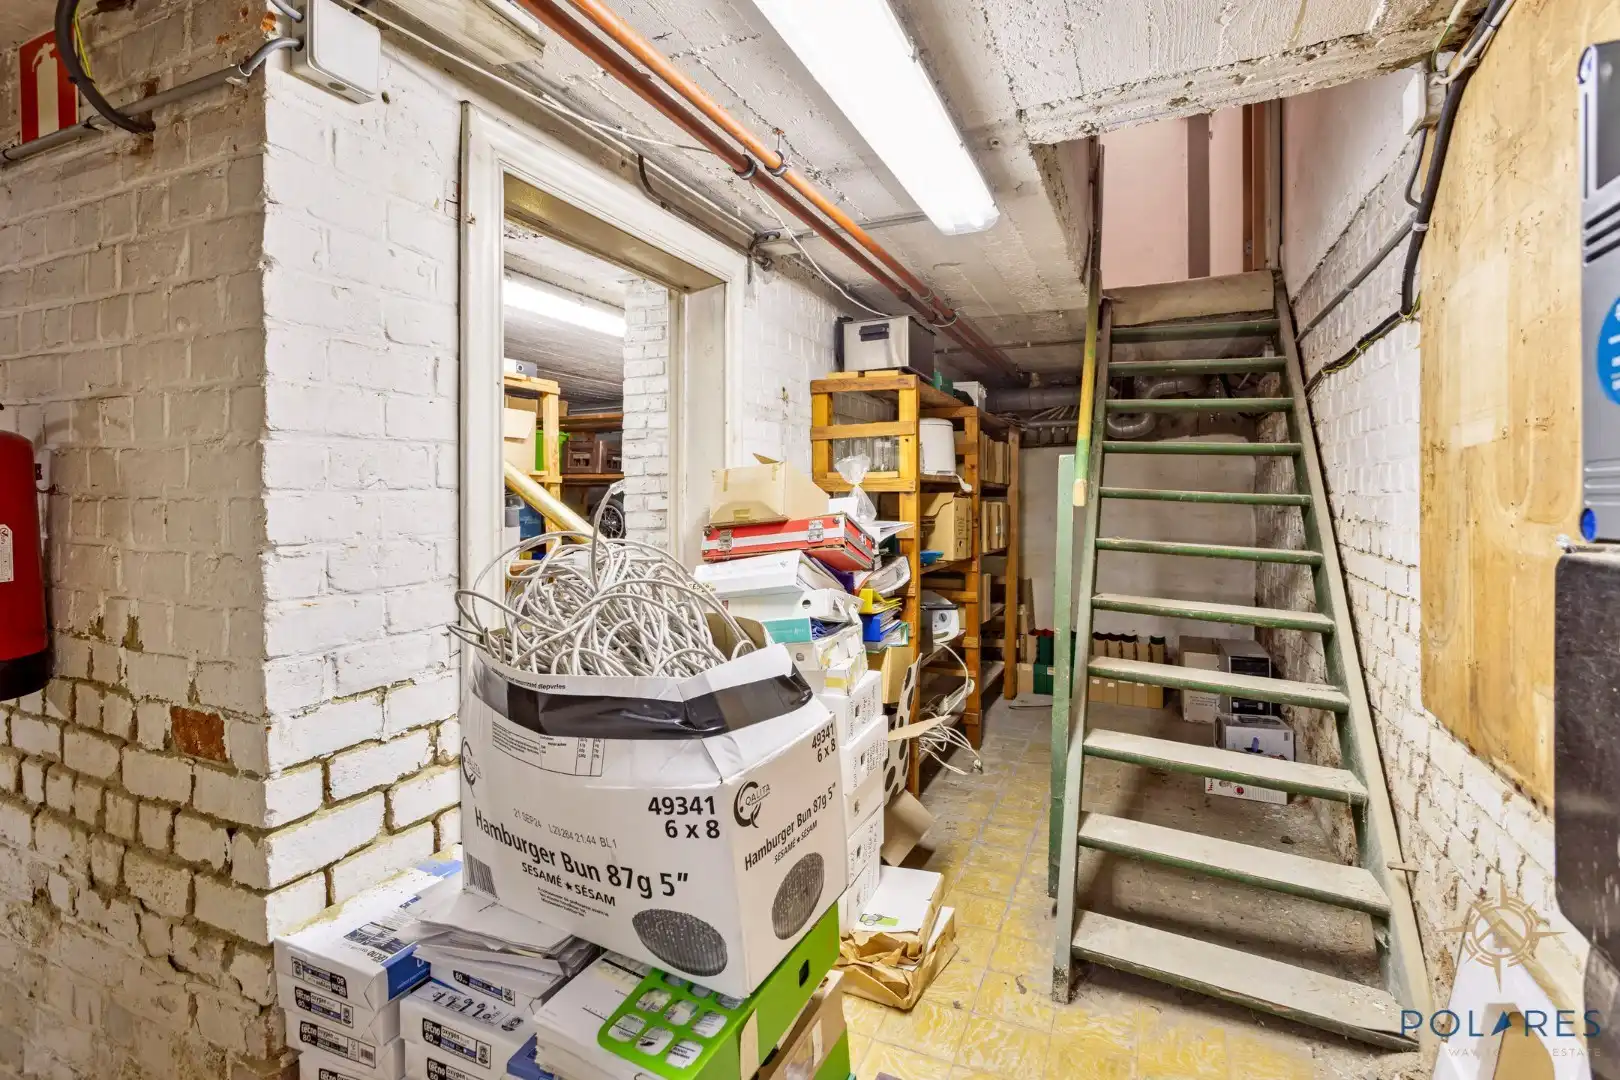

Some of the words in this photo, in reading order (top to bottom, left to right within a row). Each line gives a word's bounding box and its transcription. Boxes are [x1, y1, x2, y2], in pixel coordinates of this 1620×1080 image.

[812, 722, 834, 750] 49341
[817, 750, 823, 763] 6
[824, 745, 830, 757] x
[831, 738, 836, 752] 8
[745, 783, 771, 806] QALITA
[648, 796, 716, 815] 49341
[665, 819, 679, 838] 6
[685, 823, 700, 839] x
[706, 819, 720, 839] 8
[744, 820, 795, 871] Hamburger
[796, 807, 812, 828] Bun
[813, 793, 828, 813] 87g
[828, 781, 837, 800] 5"
[474, 806, 555, 866] Hamburger
[560, 850, 601, 882] Bun
[606, 864, 653, 899] 87g
[659, 872, 689, 896] 5"
[574, 883, 616, 907] SÉSAM
[455, 973, 463, 981] 80
[302, 1034, 312, 1042] 80
[425, 1033, 434, 1042] 80
[442, 1027, 460, 1040] oxygen
